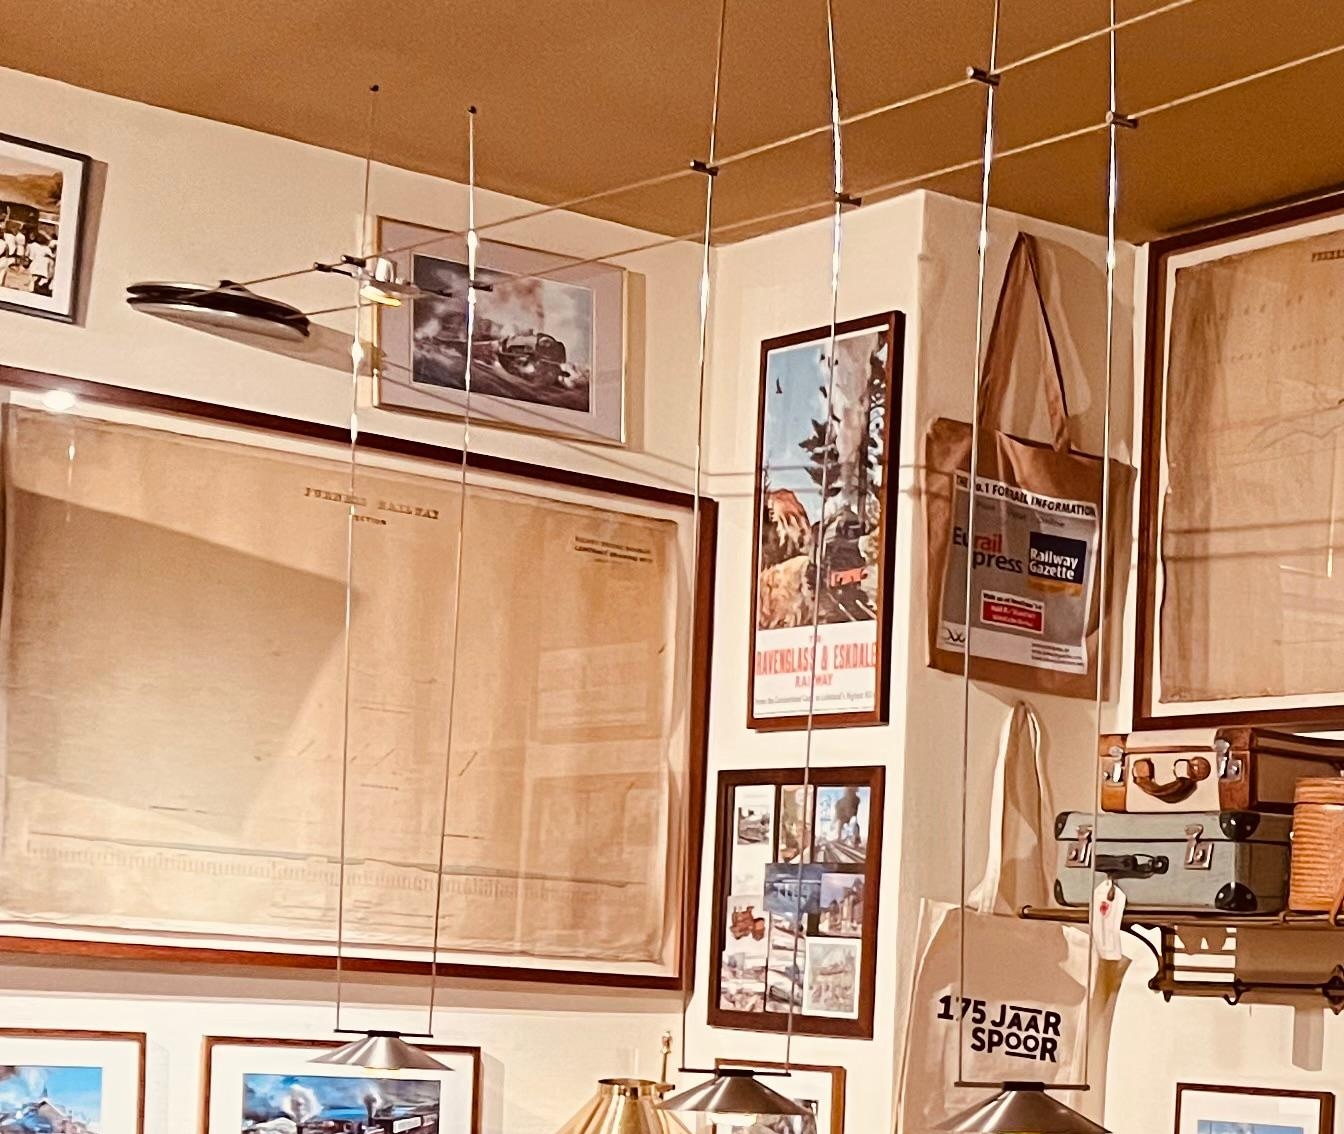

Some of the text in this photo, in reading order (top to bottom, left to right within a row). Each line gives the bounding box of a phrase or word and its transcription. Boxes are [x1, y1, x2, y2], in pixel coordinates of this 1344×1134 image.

[1030, 547, 1079, 570] Railway
[1029, 562, 1075, 580] Gazette
[794, 674, 833, 688] RAIWAY
[937, 995, 1062, 1037] 175 JAAR
[971, 1026, 1058, 1063] SPOOR
